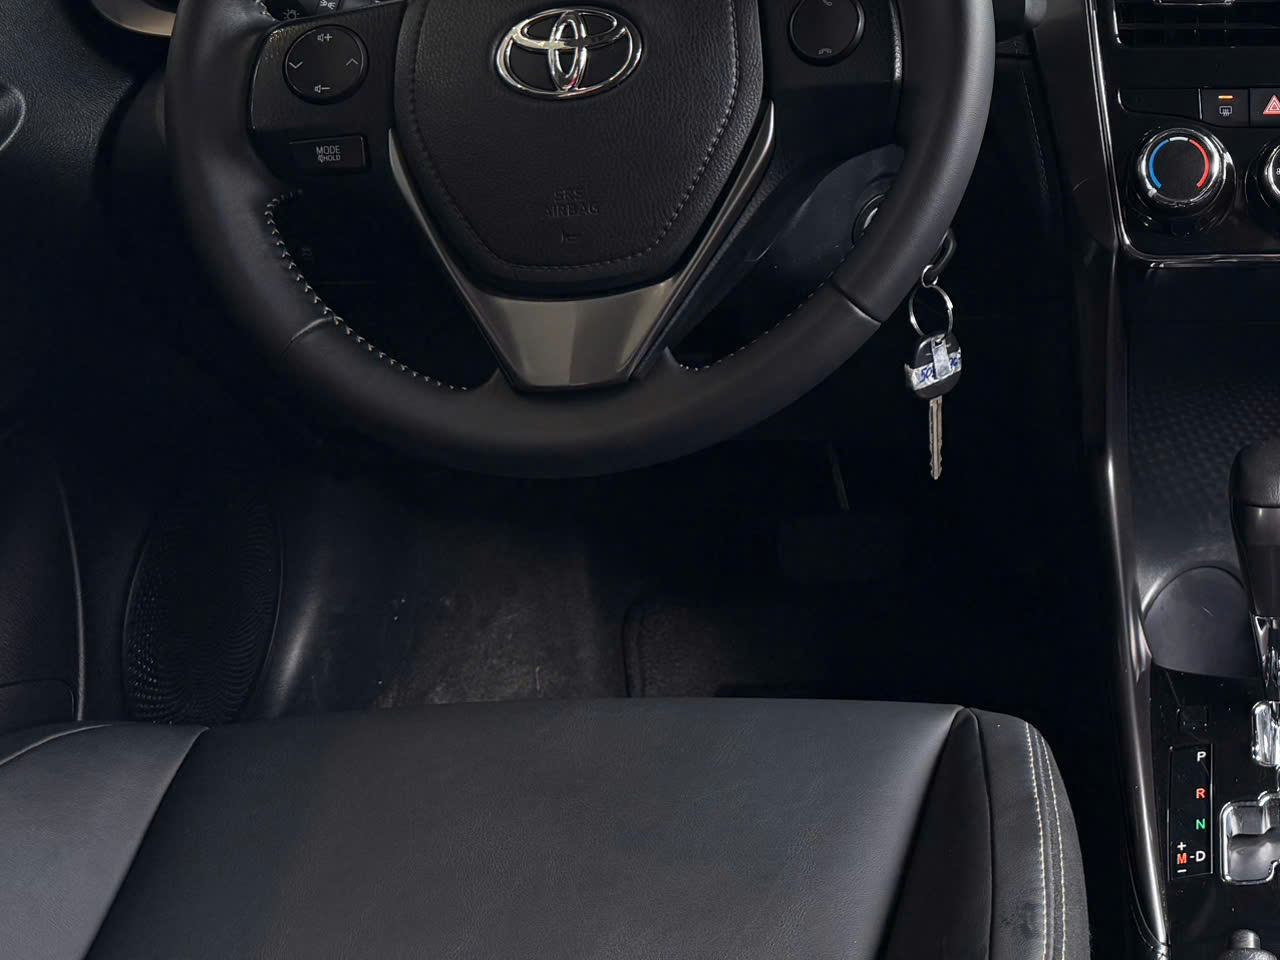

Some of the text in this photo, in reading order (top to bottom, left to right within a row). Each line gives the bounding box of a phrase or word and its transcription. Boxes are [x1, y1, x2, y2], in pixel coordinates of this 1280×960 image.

[316, 146, 340, 154] MODE
[1197, 752, 1206, 762] P
[1196, 788, 1206, 799] R
[1196, 819, 1206, 830] N
[1177, 853, 1188, 864] M
